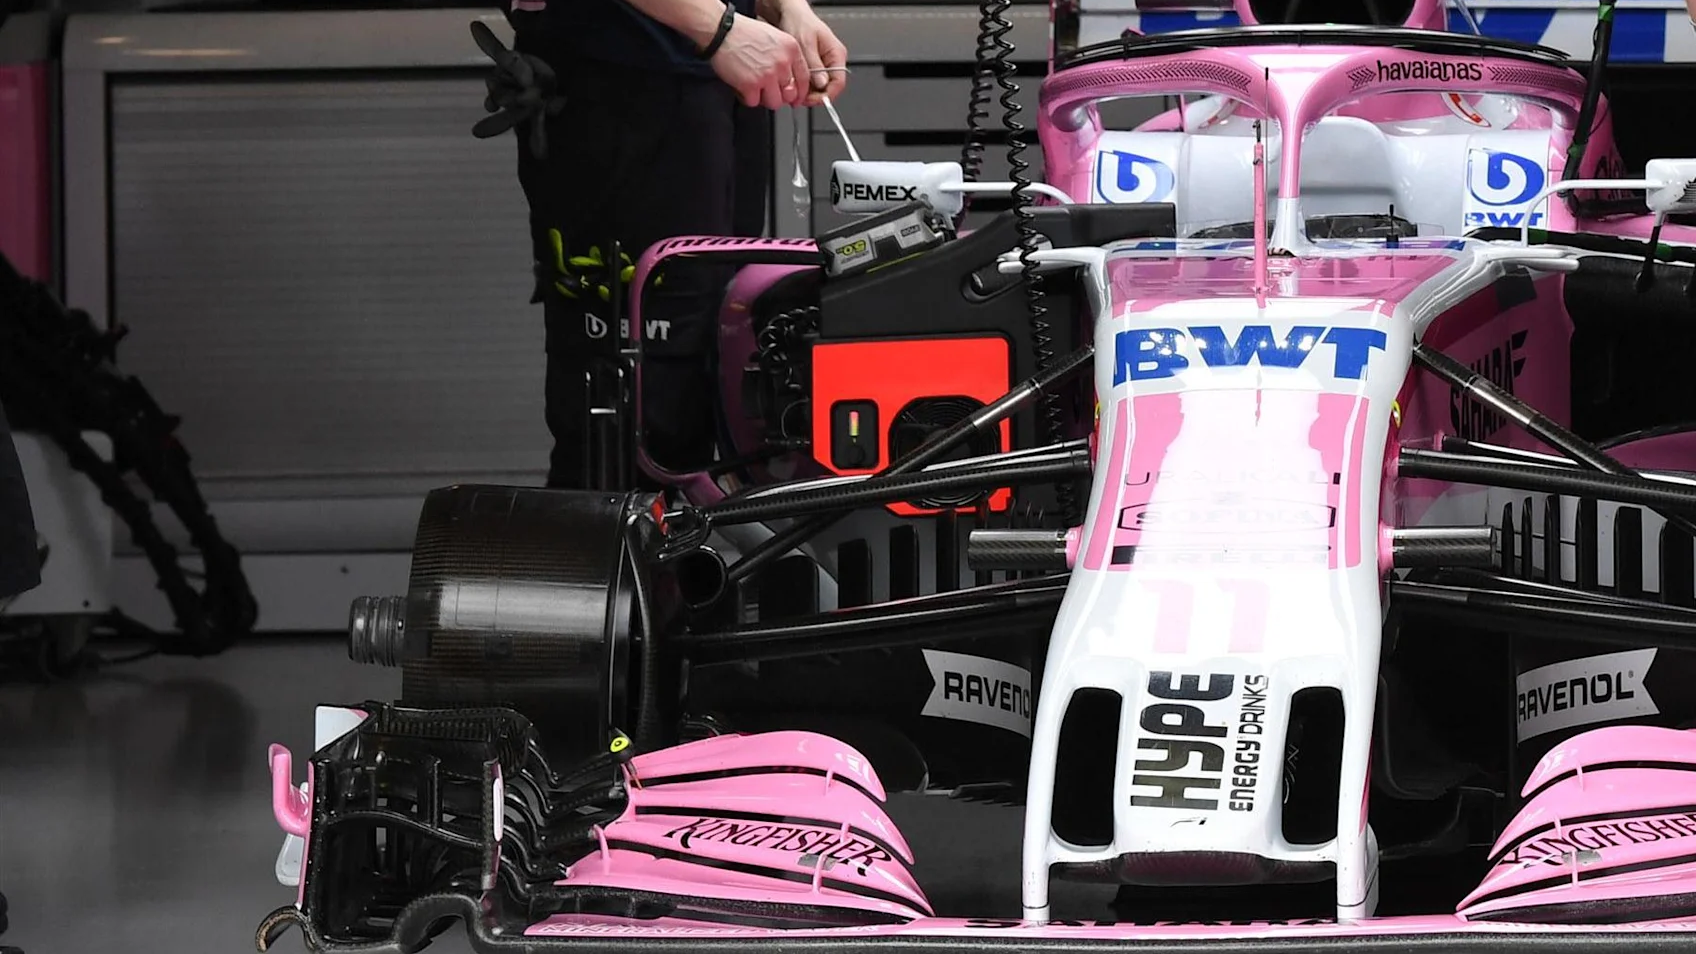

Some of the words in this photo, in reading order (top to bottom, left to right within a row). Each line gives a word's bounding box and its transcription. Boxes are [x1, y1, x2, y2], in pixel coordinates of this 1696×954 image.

[1376, 59, 1483, 82] havaianas
[843, 182, 917, 202] PEMEX
[1465, 212, 1543, 228] BWT
[1113, 325, 1387, 388] BWT
[944, 670, 1030, 719] RAVENO
[1237, 674, 1269, 735] DRINKS
[1518, 671, 1634, 724] RAVENOL
[1130, 670, 1235, 811] HYPE
[1228, 739, 1261, 812] ENERGY
[663, 817, 893, 876] KINGFISHER
